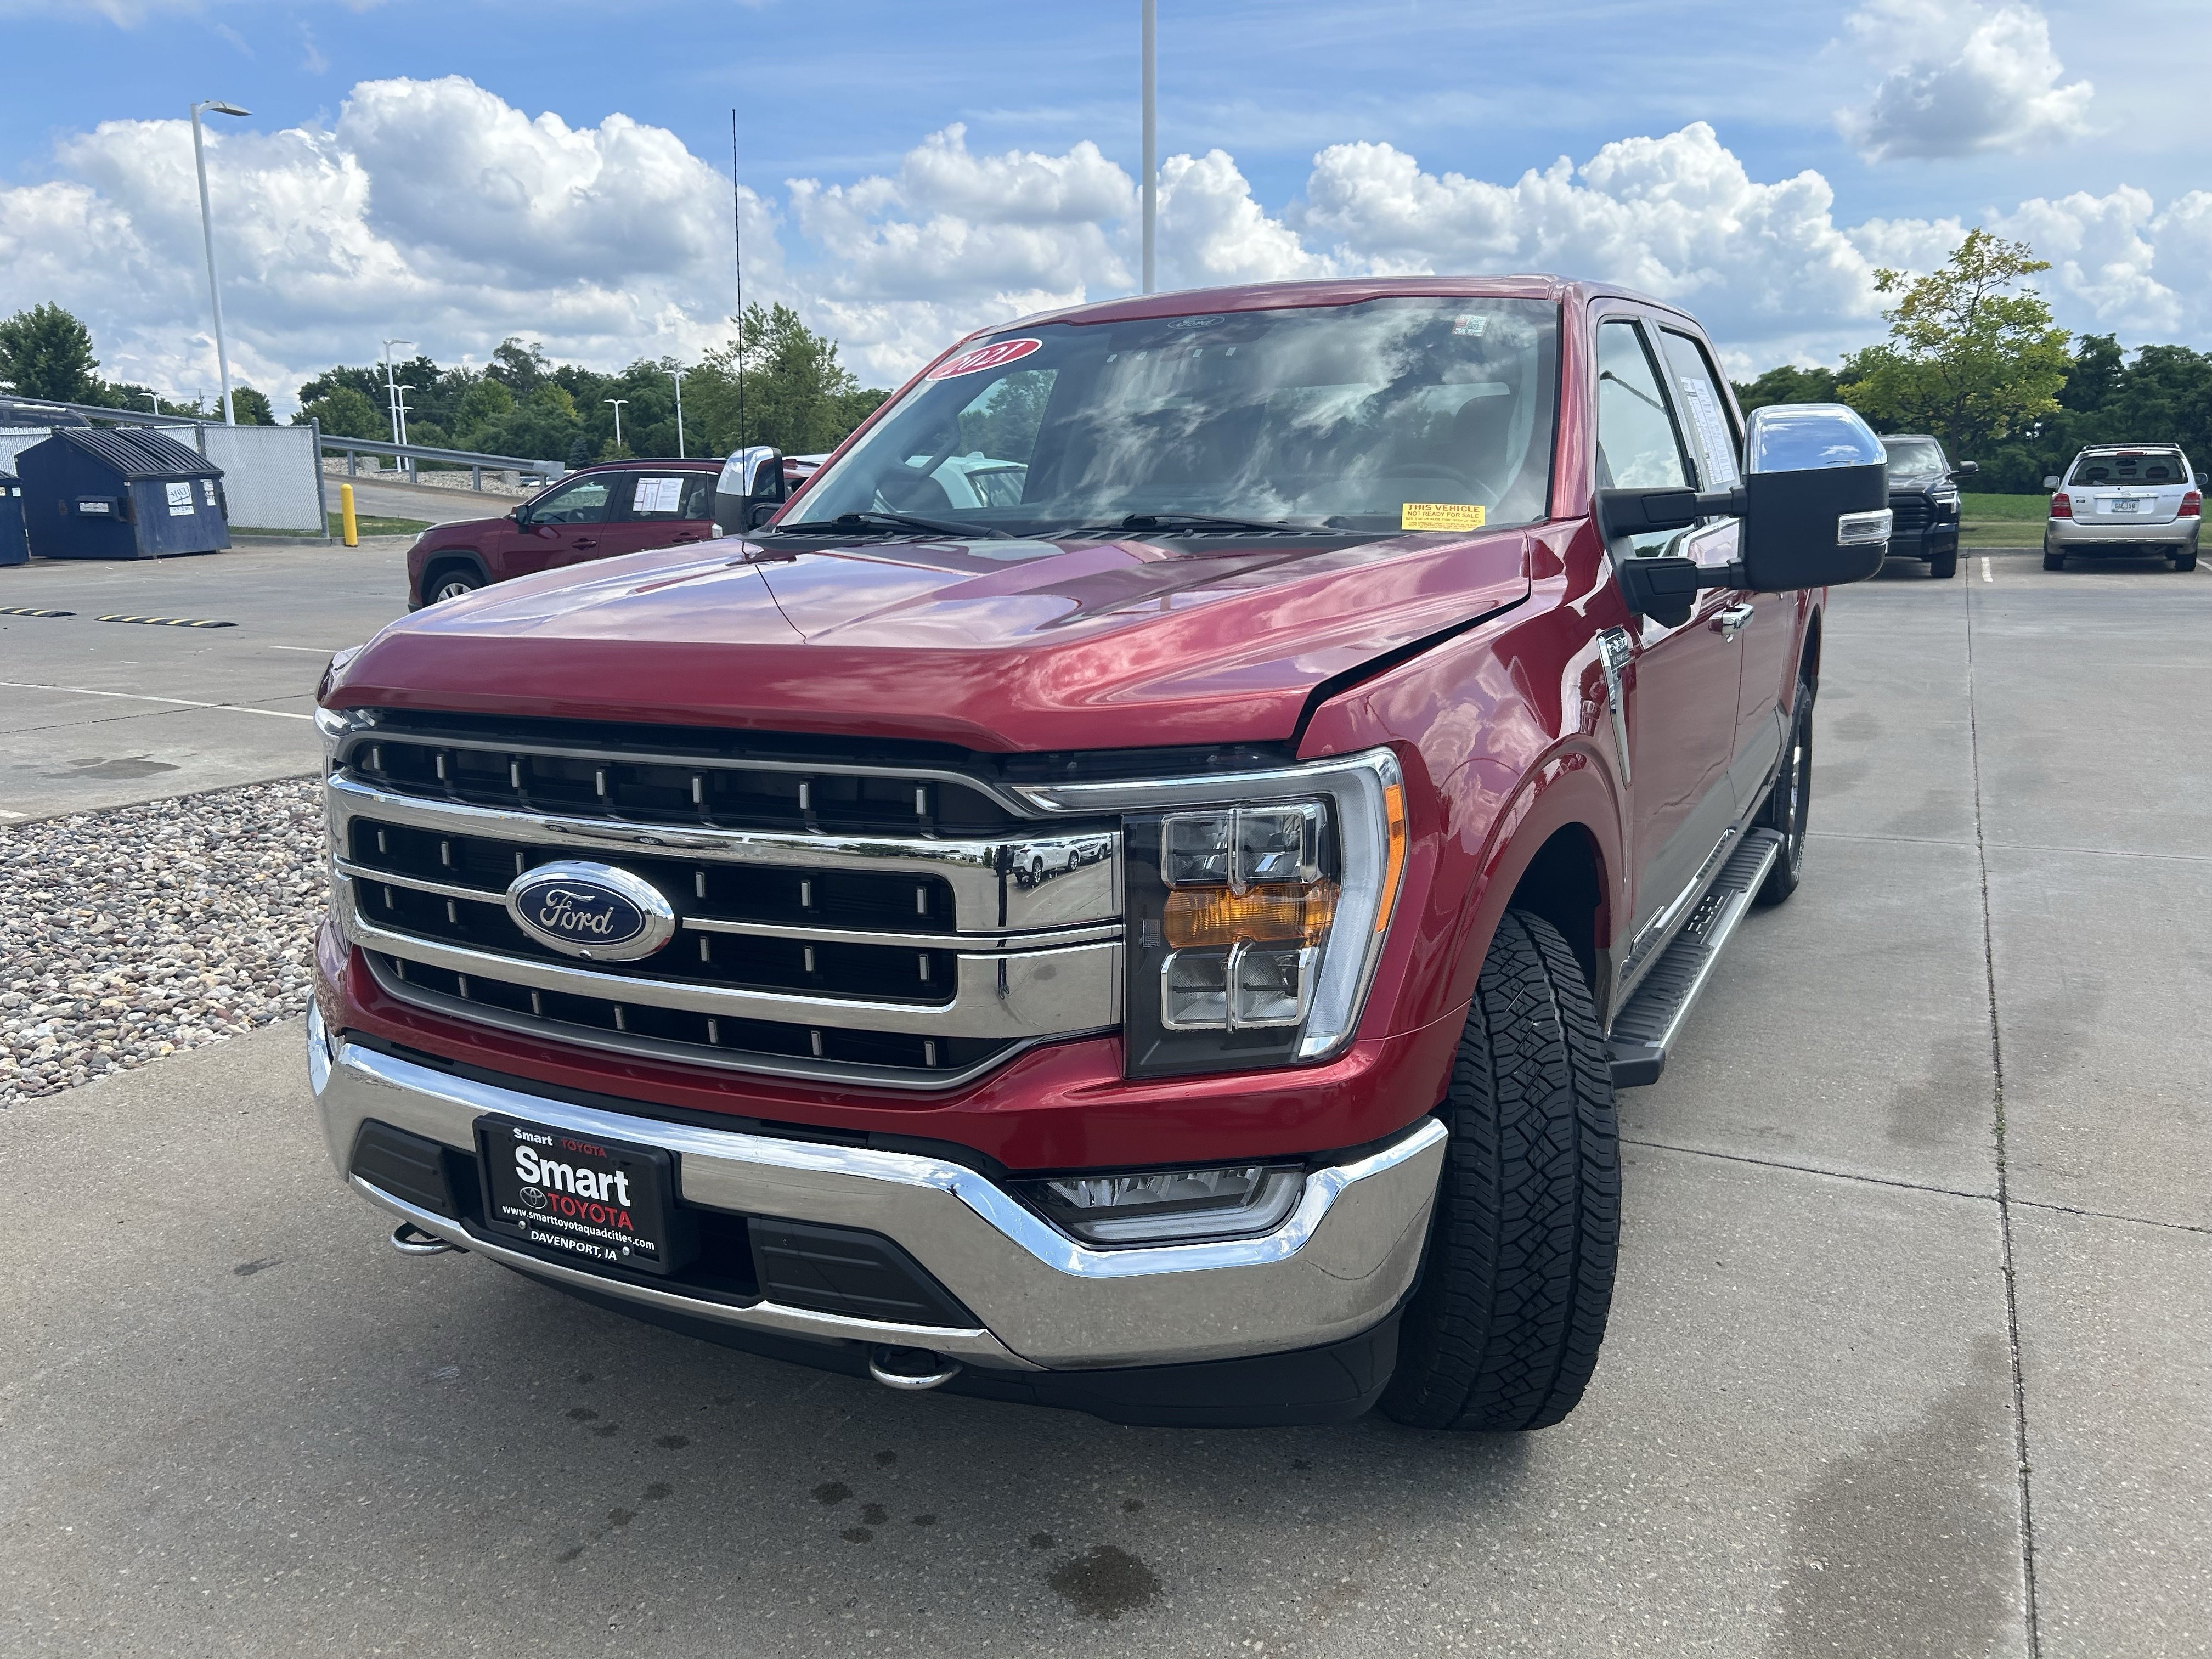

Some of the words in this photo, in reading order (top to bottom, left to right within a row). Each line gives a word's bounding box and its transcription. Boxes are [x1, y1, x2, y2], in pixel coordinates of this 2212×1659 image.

[1176, 318, 1216, 327] Ford
[1435, 505, 1480, 513] VEHICLE
[539, 889, 614, 935] Ford
[514, 1128, 553, 1146] Smart
[561, 1139, 607, 1158] TOYOTA
[515, 1146, 631, 1207] Smart
[502, 1205, 654, 1250] www.smarttoyotaquadcities.com
[548, 1192, 634, 1231] TOYOTA
[531, 1230, 602, 1259] DAVENPORT,
[605, 1249, 617, 1261] IA
